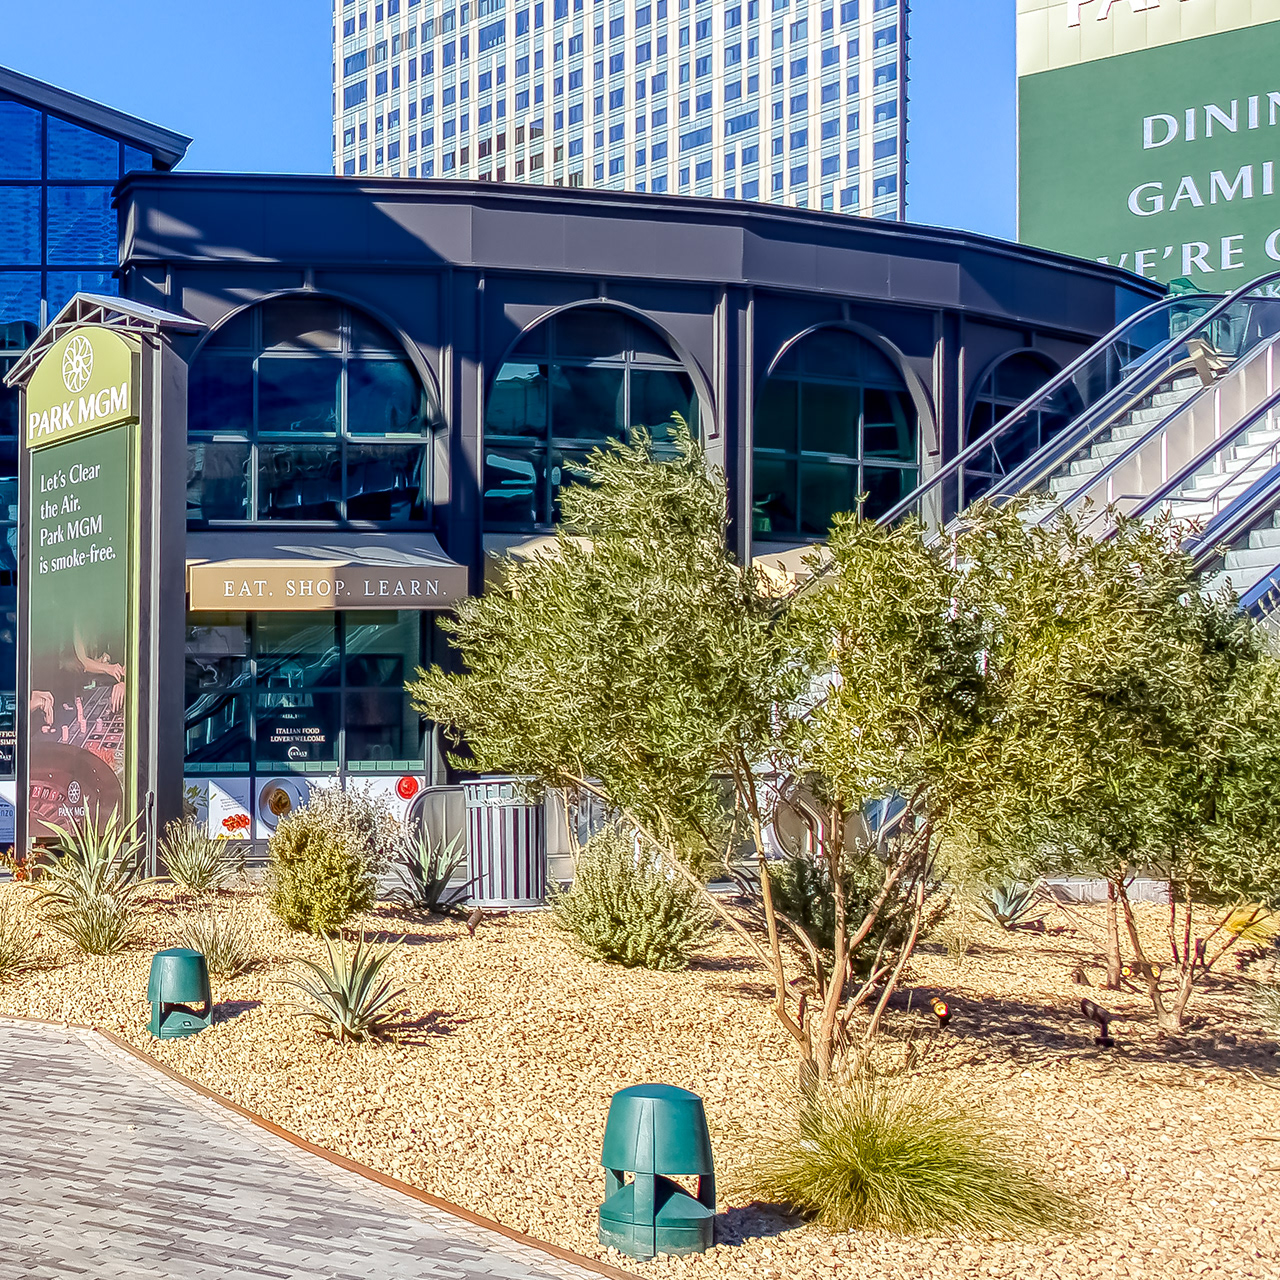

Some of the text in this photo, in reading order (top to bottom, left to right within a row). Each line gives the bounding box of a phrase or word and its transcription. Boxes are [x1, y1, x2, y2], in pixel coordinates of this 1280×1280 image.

[1126, 161, 1274, 217] GAMI
[29, 382, 128, 440] PARK MGM
[40, 463, 101, 493] Let's Clear
[40, 494, 81, 520] the Air.
[40, 514, 103, 547] Park MGM
[39, 543, 116, 574] is smoke-free.
[223, 579, 448, 597] EAT. SHOP. LEARN.
